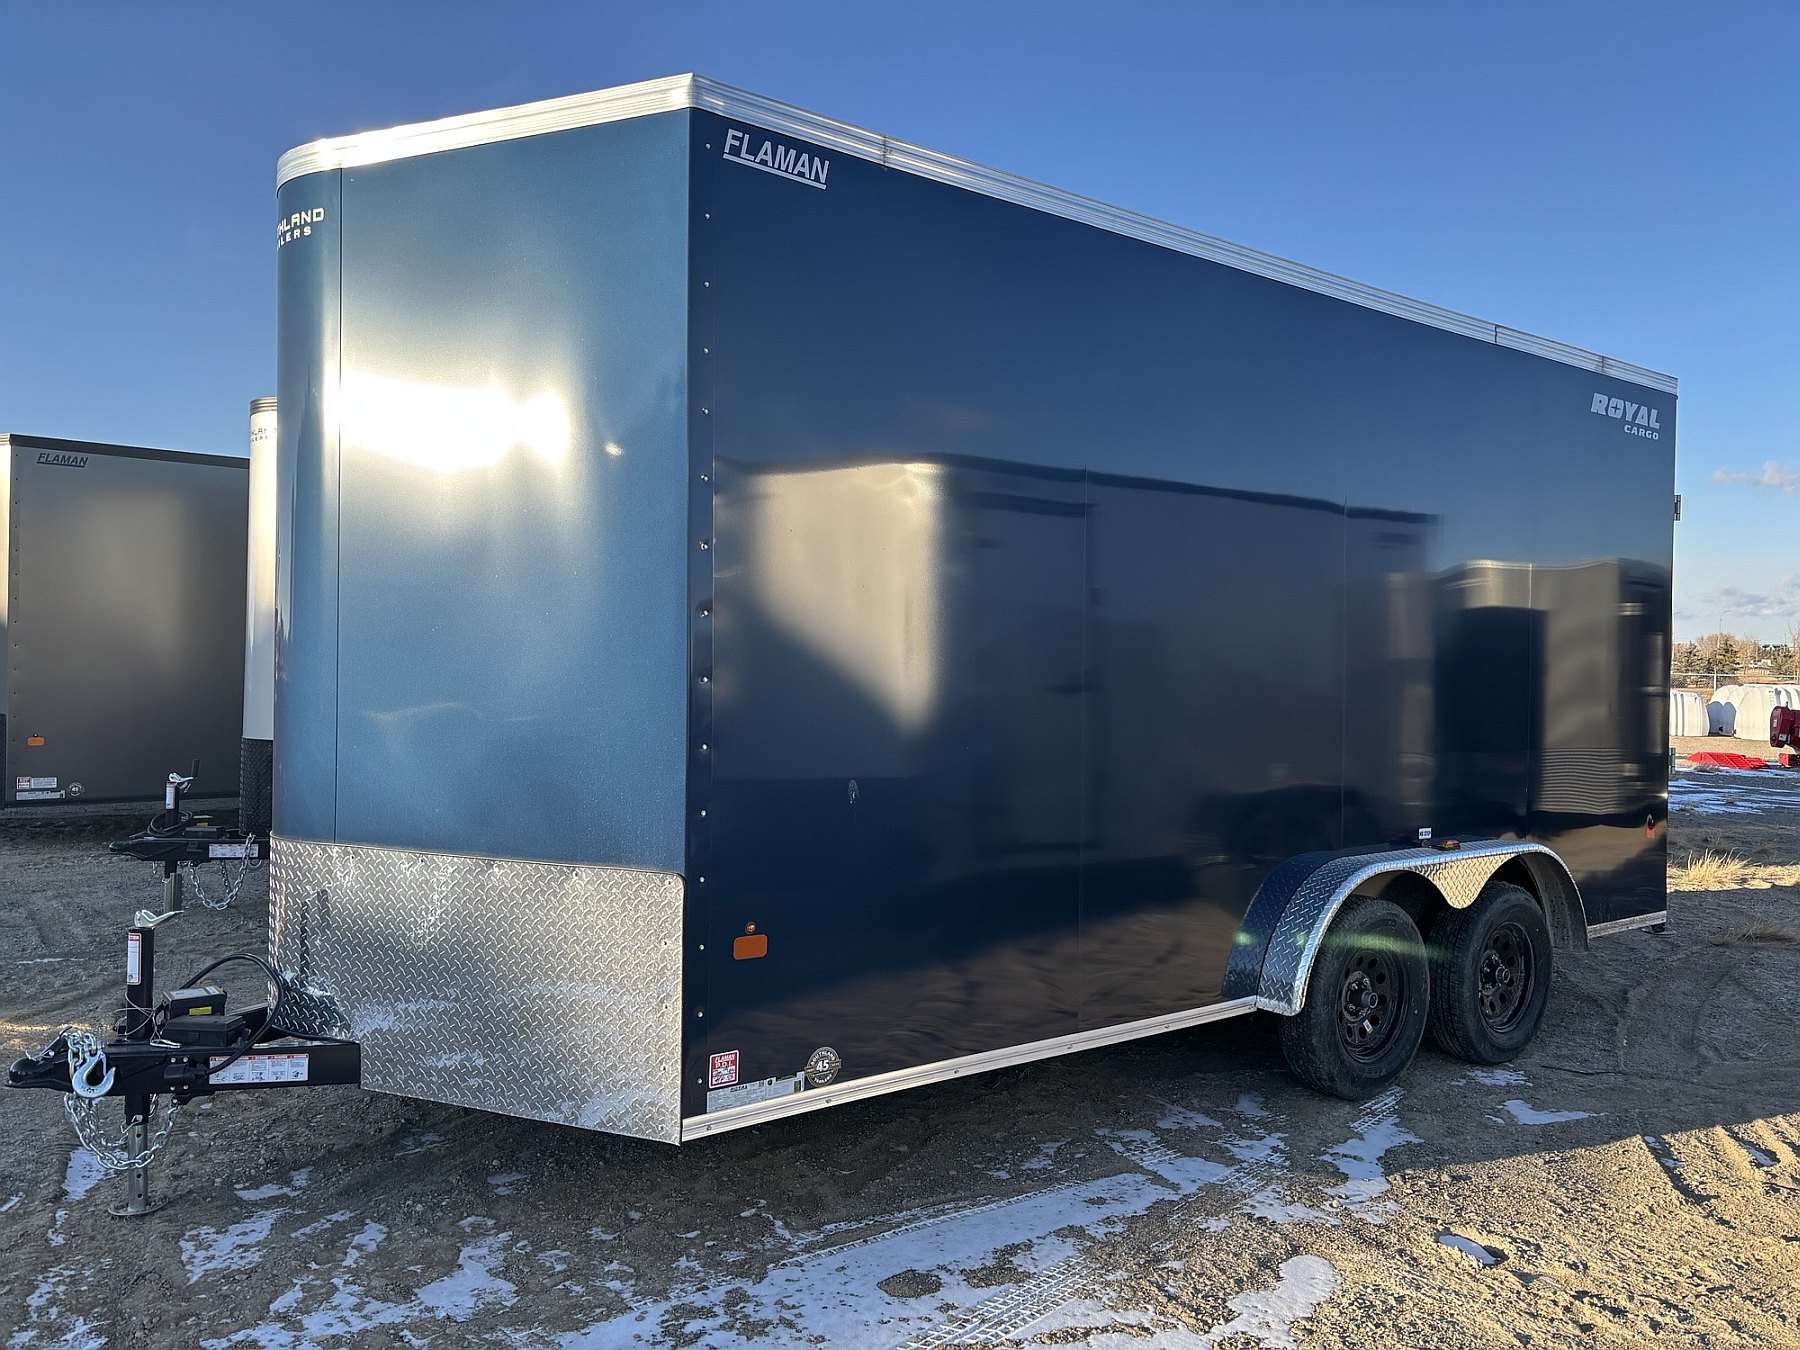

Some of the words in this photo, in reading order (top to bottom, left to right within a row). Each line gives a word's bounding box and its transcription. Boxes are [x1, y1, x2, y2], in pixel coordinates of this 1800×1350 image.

[724, 128, 830, 184] FLAMAN
[278, 226, 312, 249] ILERS
[1590, 392, 1661, 430] ROYAL
[1623, 424, 1660, 440] CARGO
[38, 452, 89, 466] FLAMAN
[816, 1059, 829, 1072] 45
